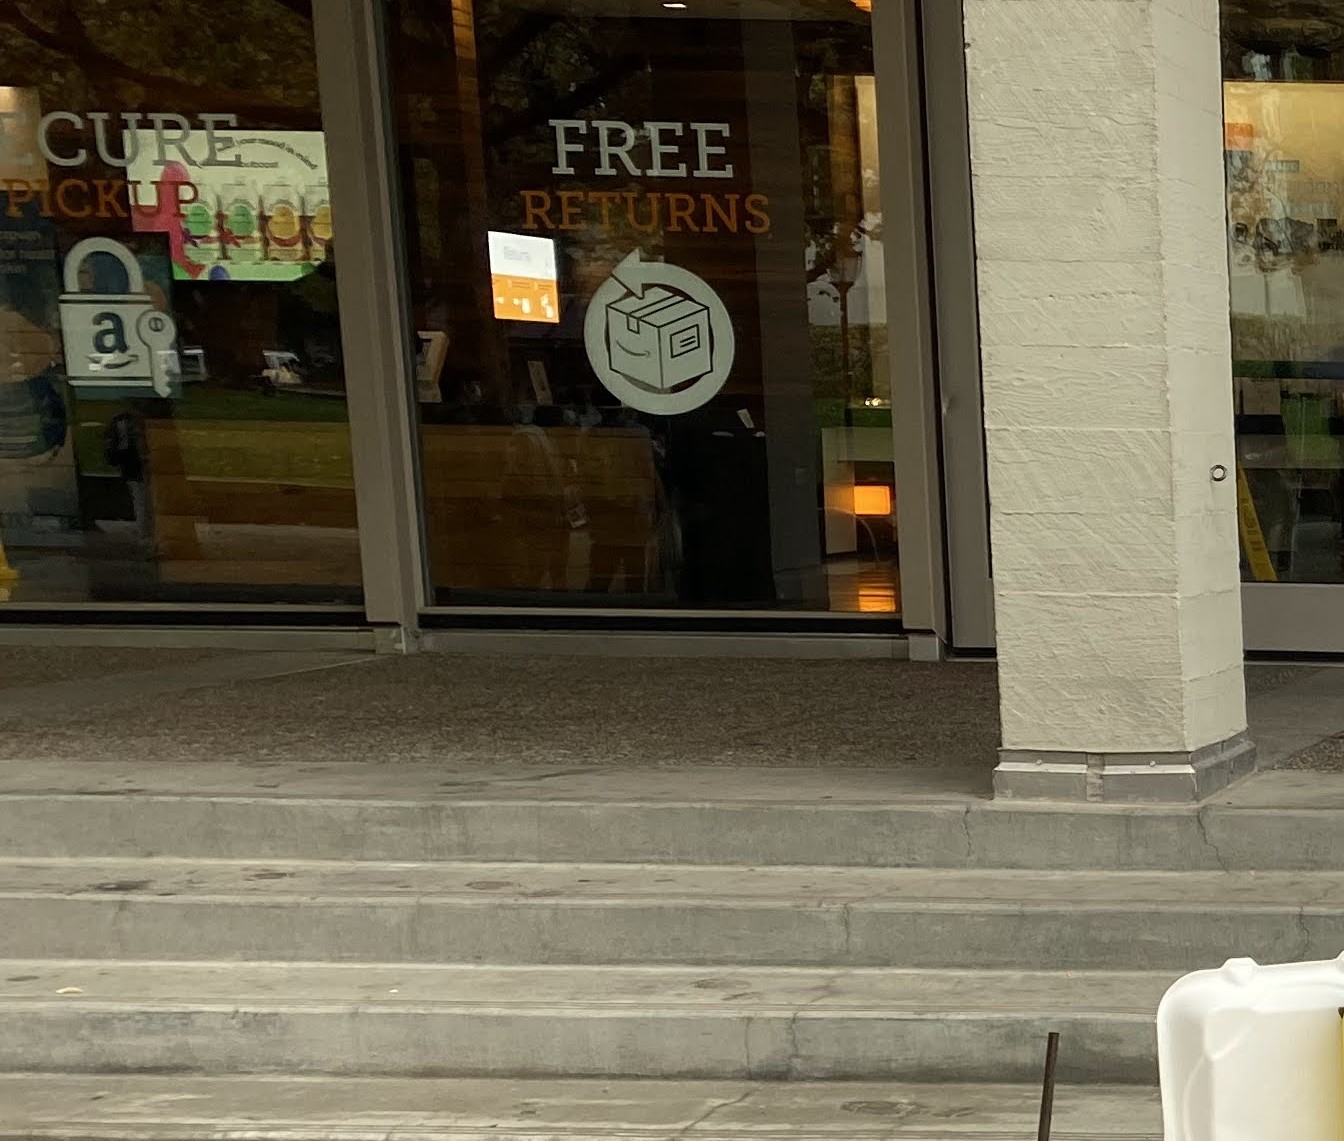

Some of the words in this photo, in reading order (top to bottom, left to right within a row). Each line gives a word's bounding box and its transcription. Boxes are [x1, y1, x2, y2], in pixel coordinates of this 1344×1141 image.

[549, 119, 734, 178] FREE
[1, 178, 200, 219] PICKUP
[520, 190, 771, 234] RETURNS
